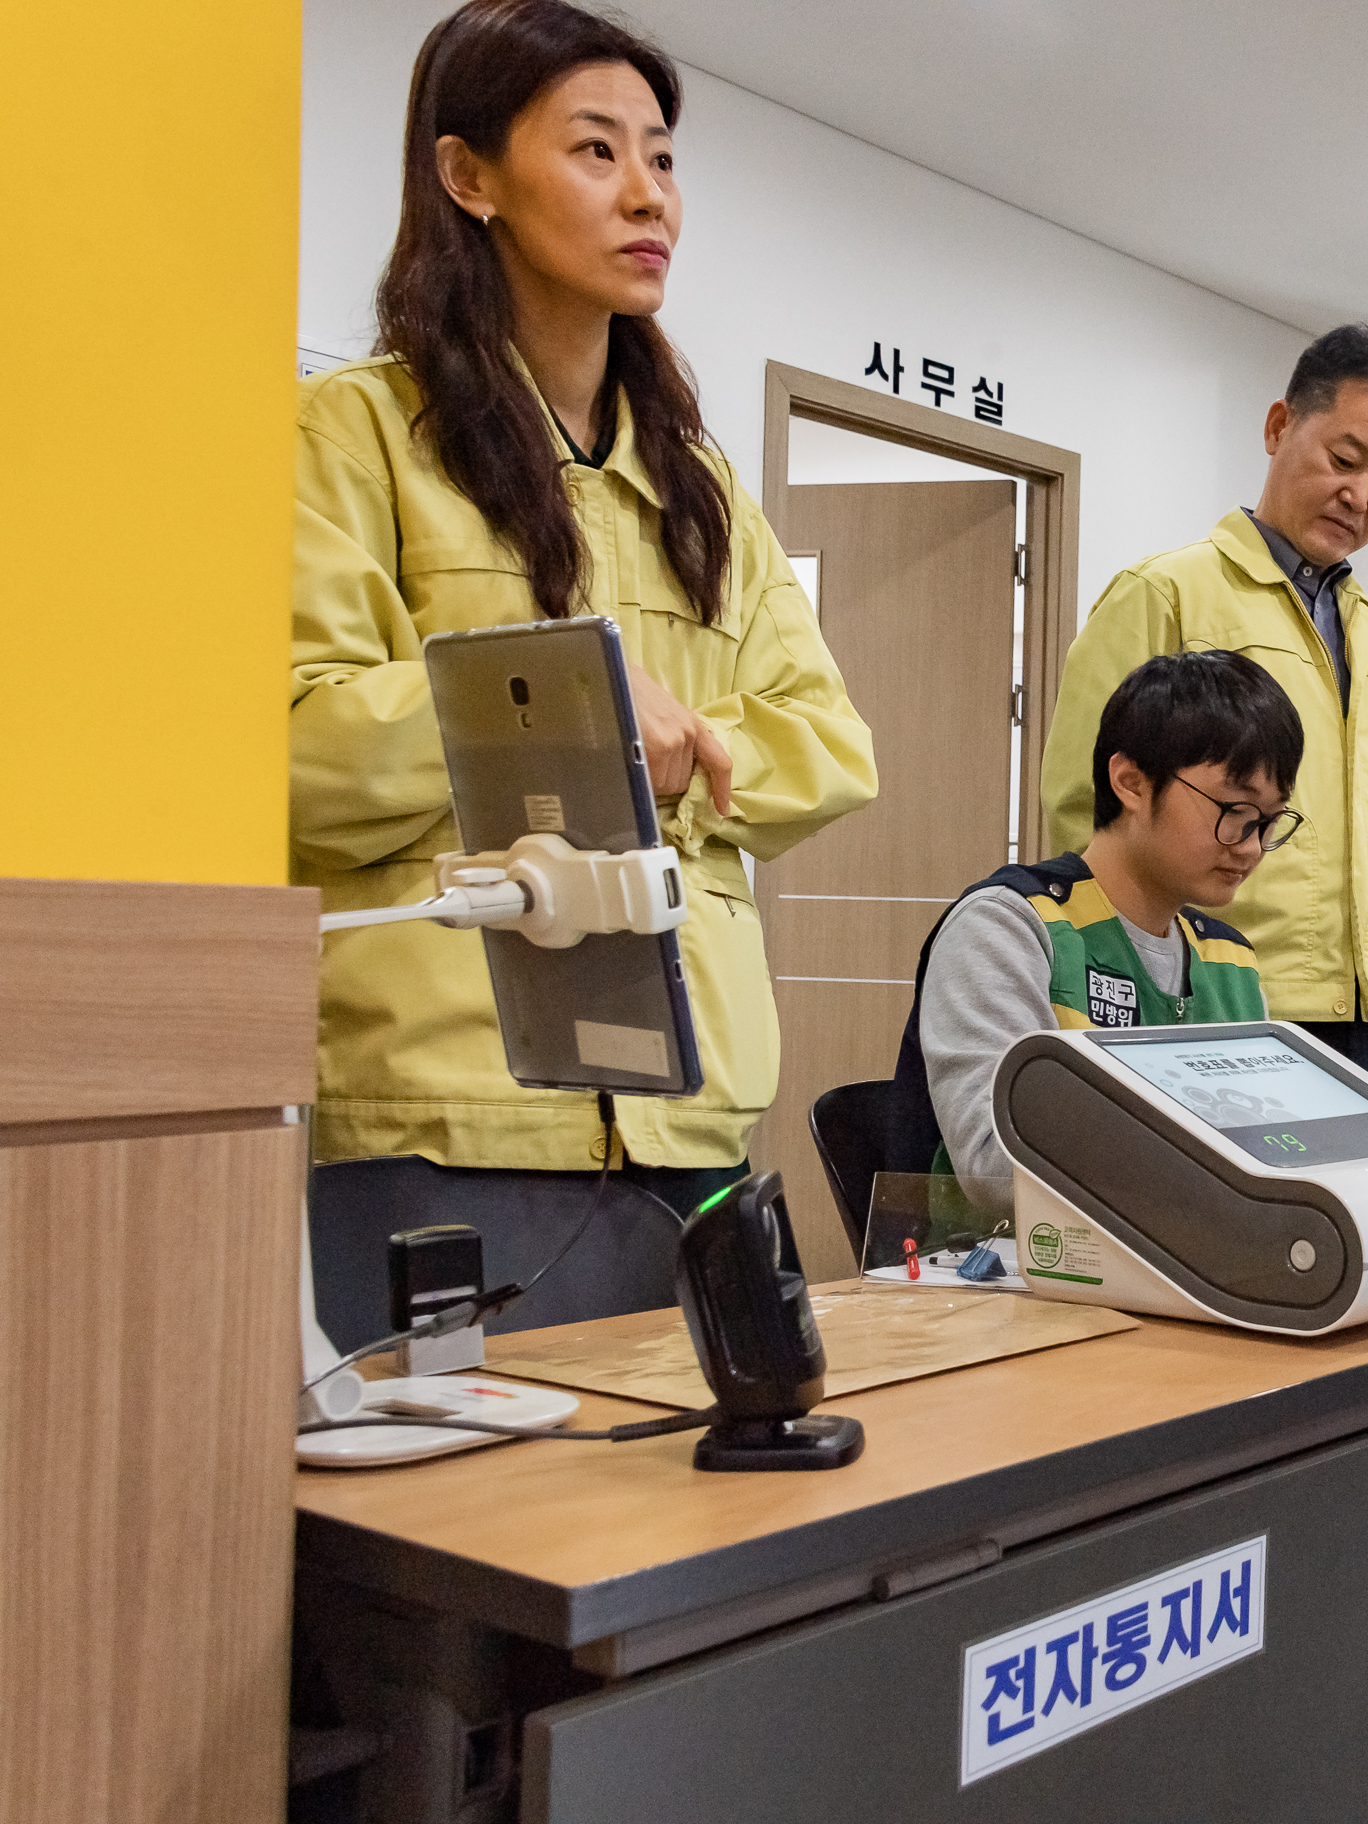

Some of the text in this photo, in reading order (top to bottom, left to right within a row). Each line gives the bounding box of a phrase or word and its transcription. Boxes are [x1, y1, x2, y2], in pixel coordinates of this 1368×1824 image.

[864, 341, 1004, 426] 사무실
[1092, 975, 1135, 1001] 광진구
[1091, 1000, 1133, 1028] 민방위
[1183, 1059, 1239, 1072] 번호표를
[1264, 1134, 1306, 1151] 79
[980, 1558, 1253, 1747] 전자통지서
